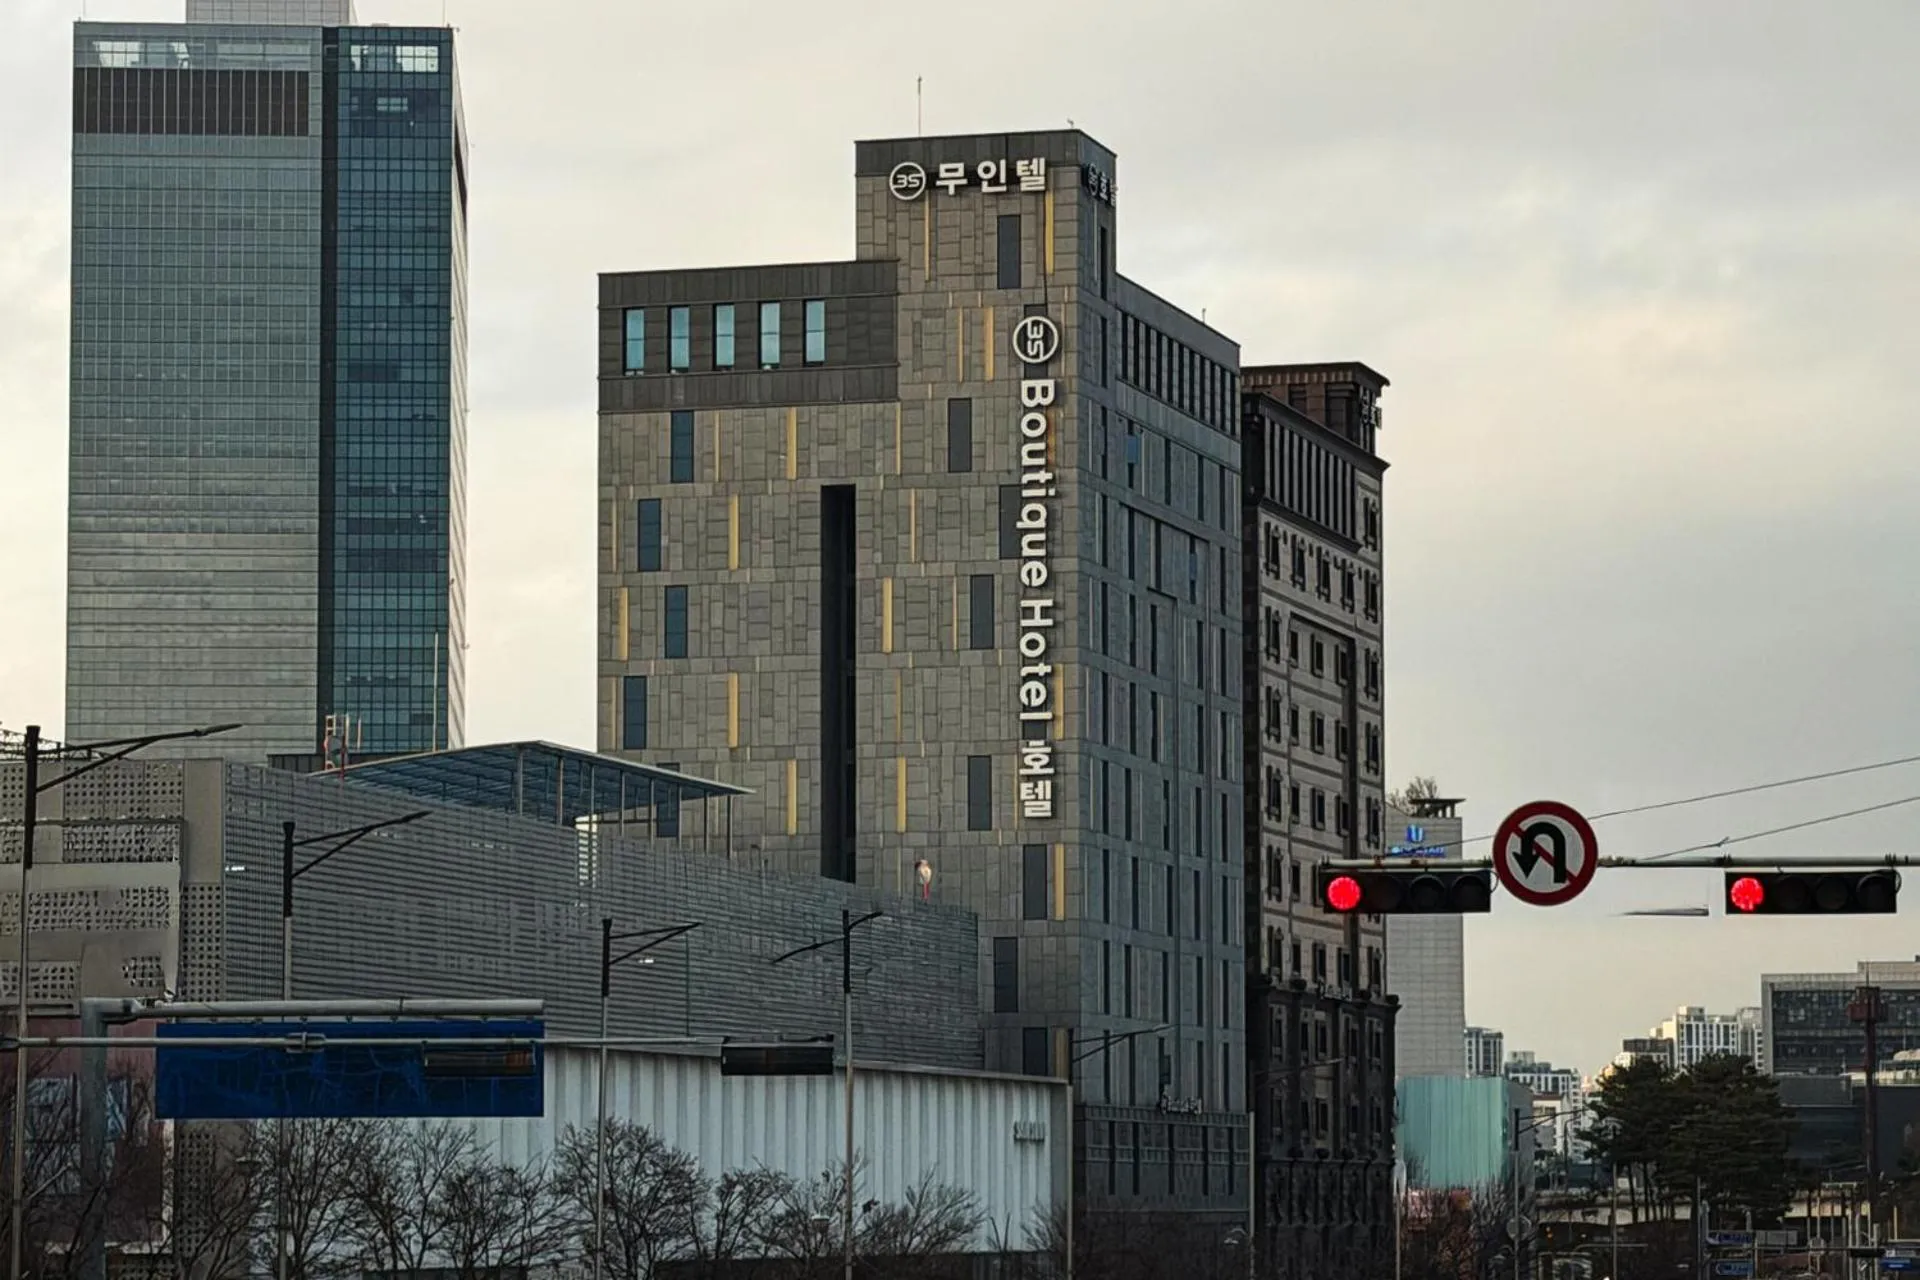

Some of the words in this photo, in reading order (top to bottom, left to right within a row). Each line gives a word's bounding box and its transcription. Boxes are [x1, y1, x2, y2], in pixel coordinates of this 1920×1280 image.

[935, 157, 1046, 195] 무인텔
[1016, 379, 1056, 587] Boutique
[1019, 599, 1054, 720] Hotel
[1019, 739, 1054, 818] 호텔
